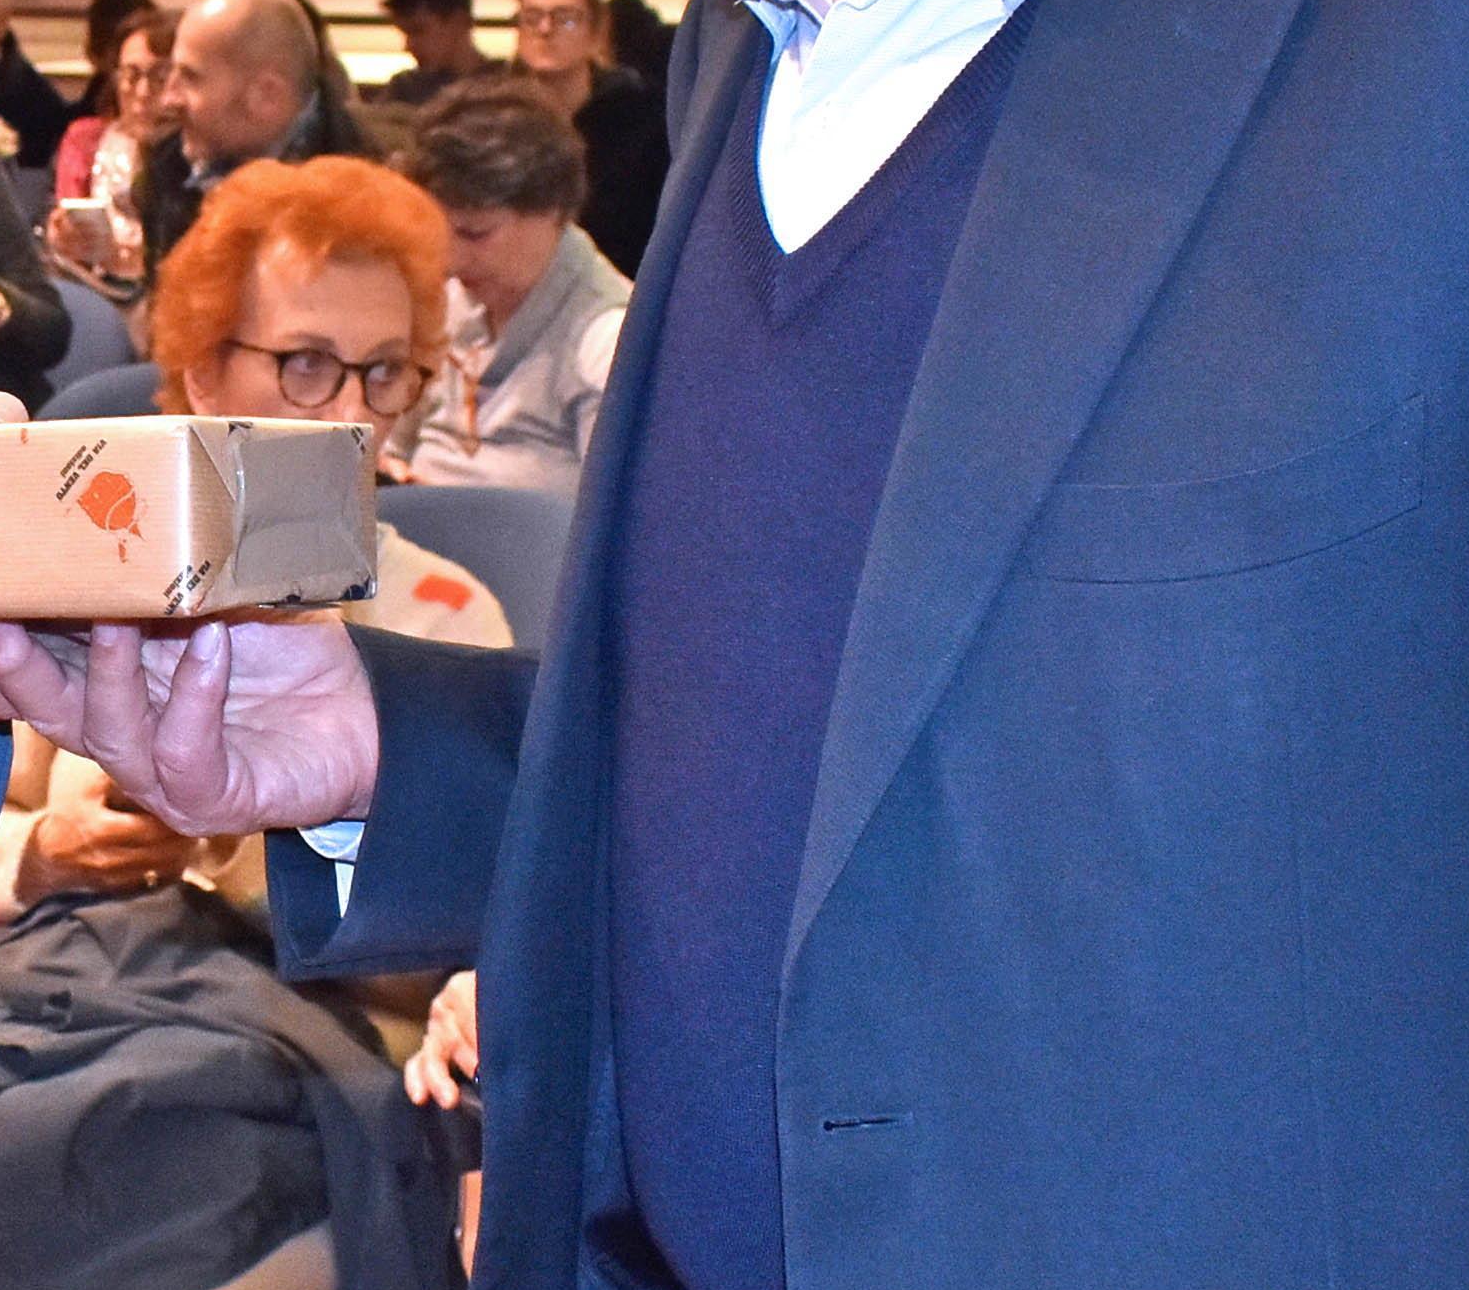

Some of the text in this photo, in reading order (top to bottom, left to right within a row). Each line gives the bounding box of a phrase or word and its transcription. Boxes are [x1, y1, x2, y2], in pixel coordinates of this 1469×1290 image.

[55, 439, 107, 500] VIA DEL VENTO
